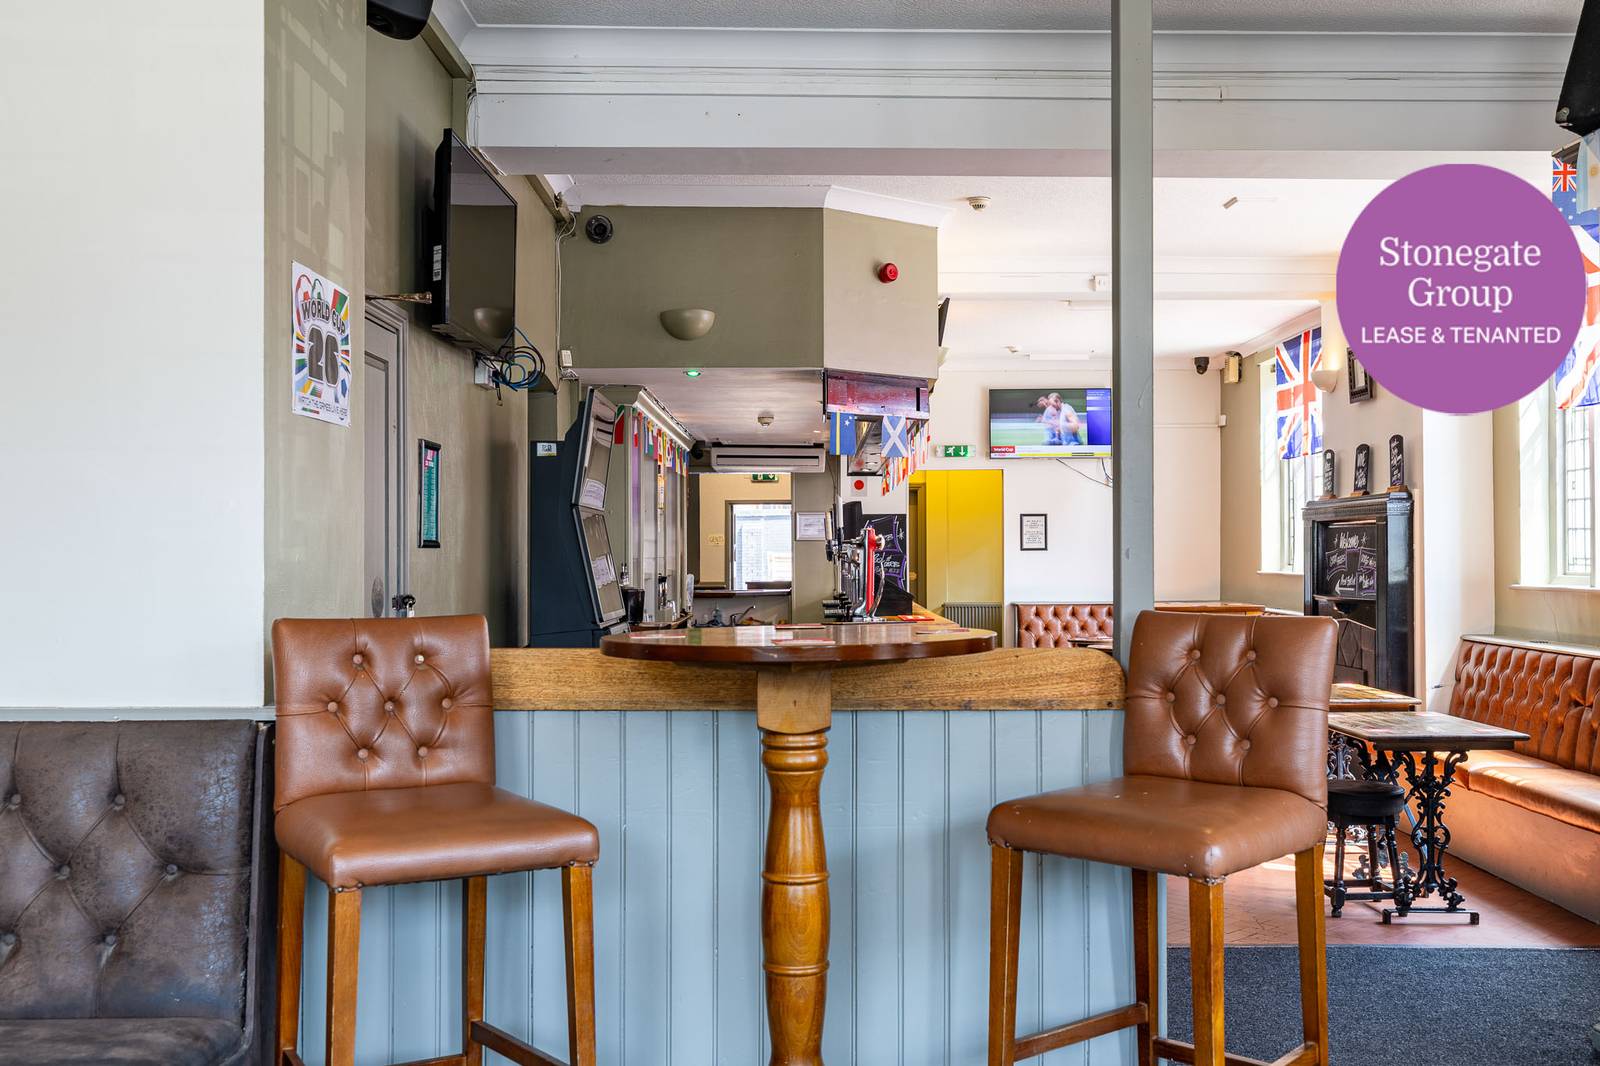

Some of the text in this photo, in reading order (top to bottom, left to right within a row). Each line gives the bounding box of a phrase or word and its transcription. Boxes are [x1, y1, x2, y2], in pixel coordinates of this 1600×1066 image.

[302, 300, 346, 336] WORLD CUP
[308, 327, 339, 386] 26
